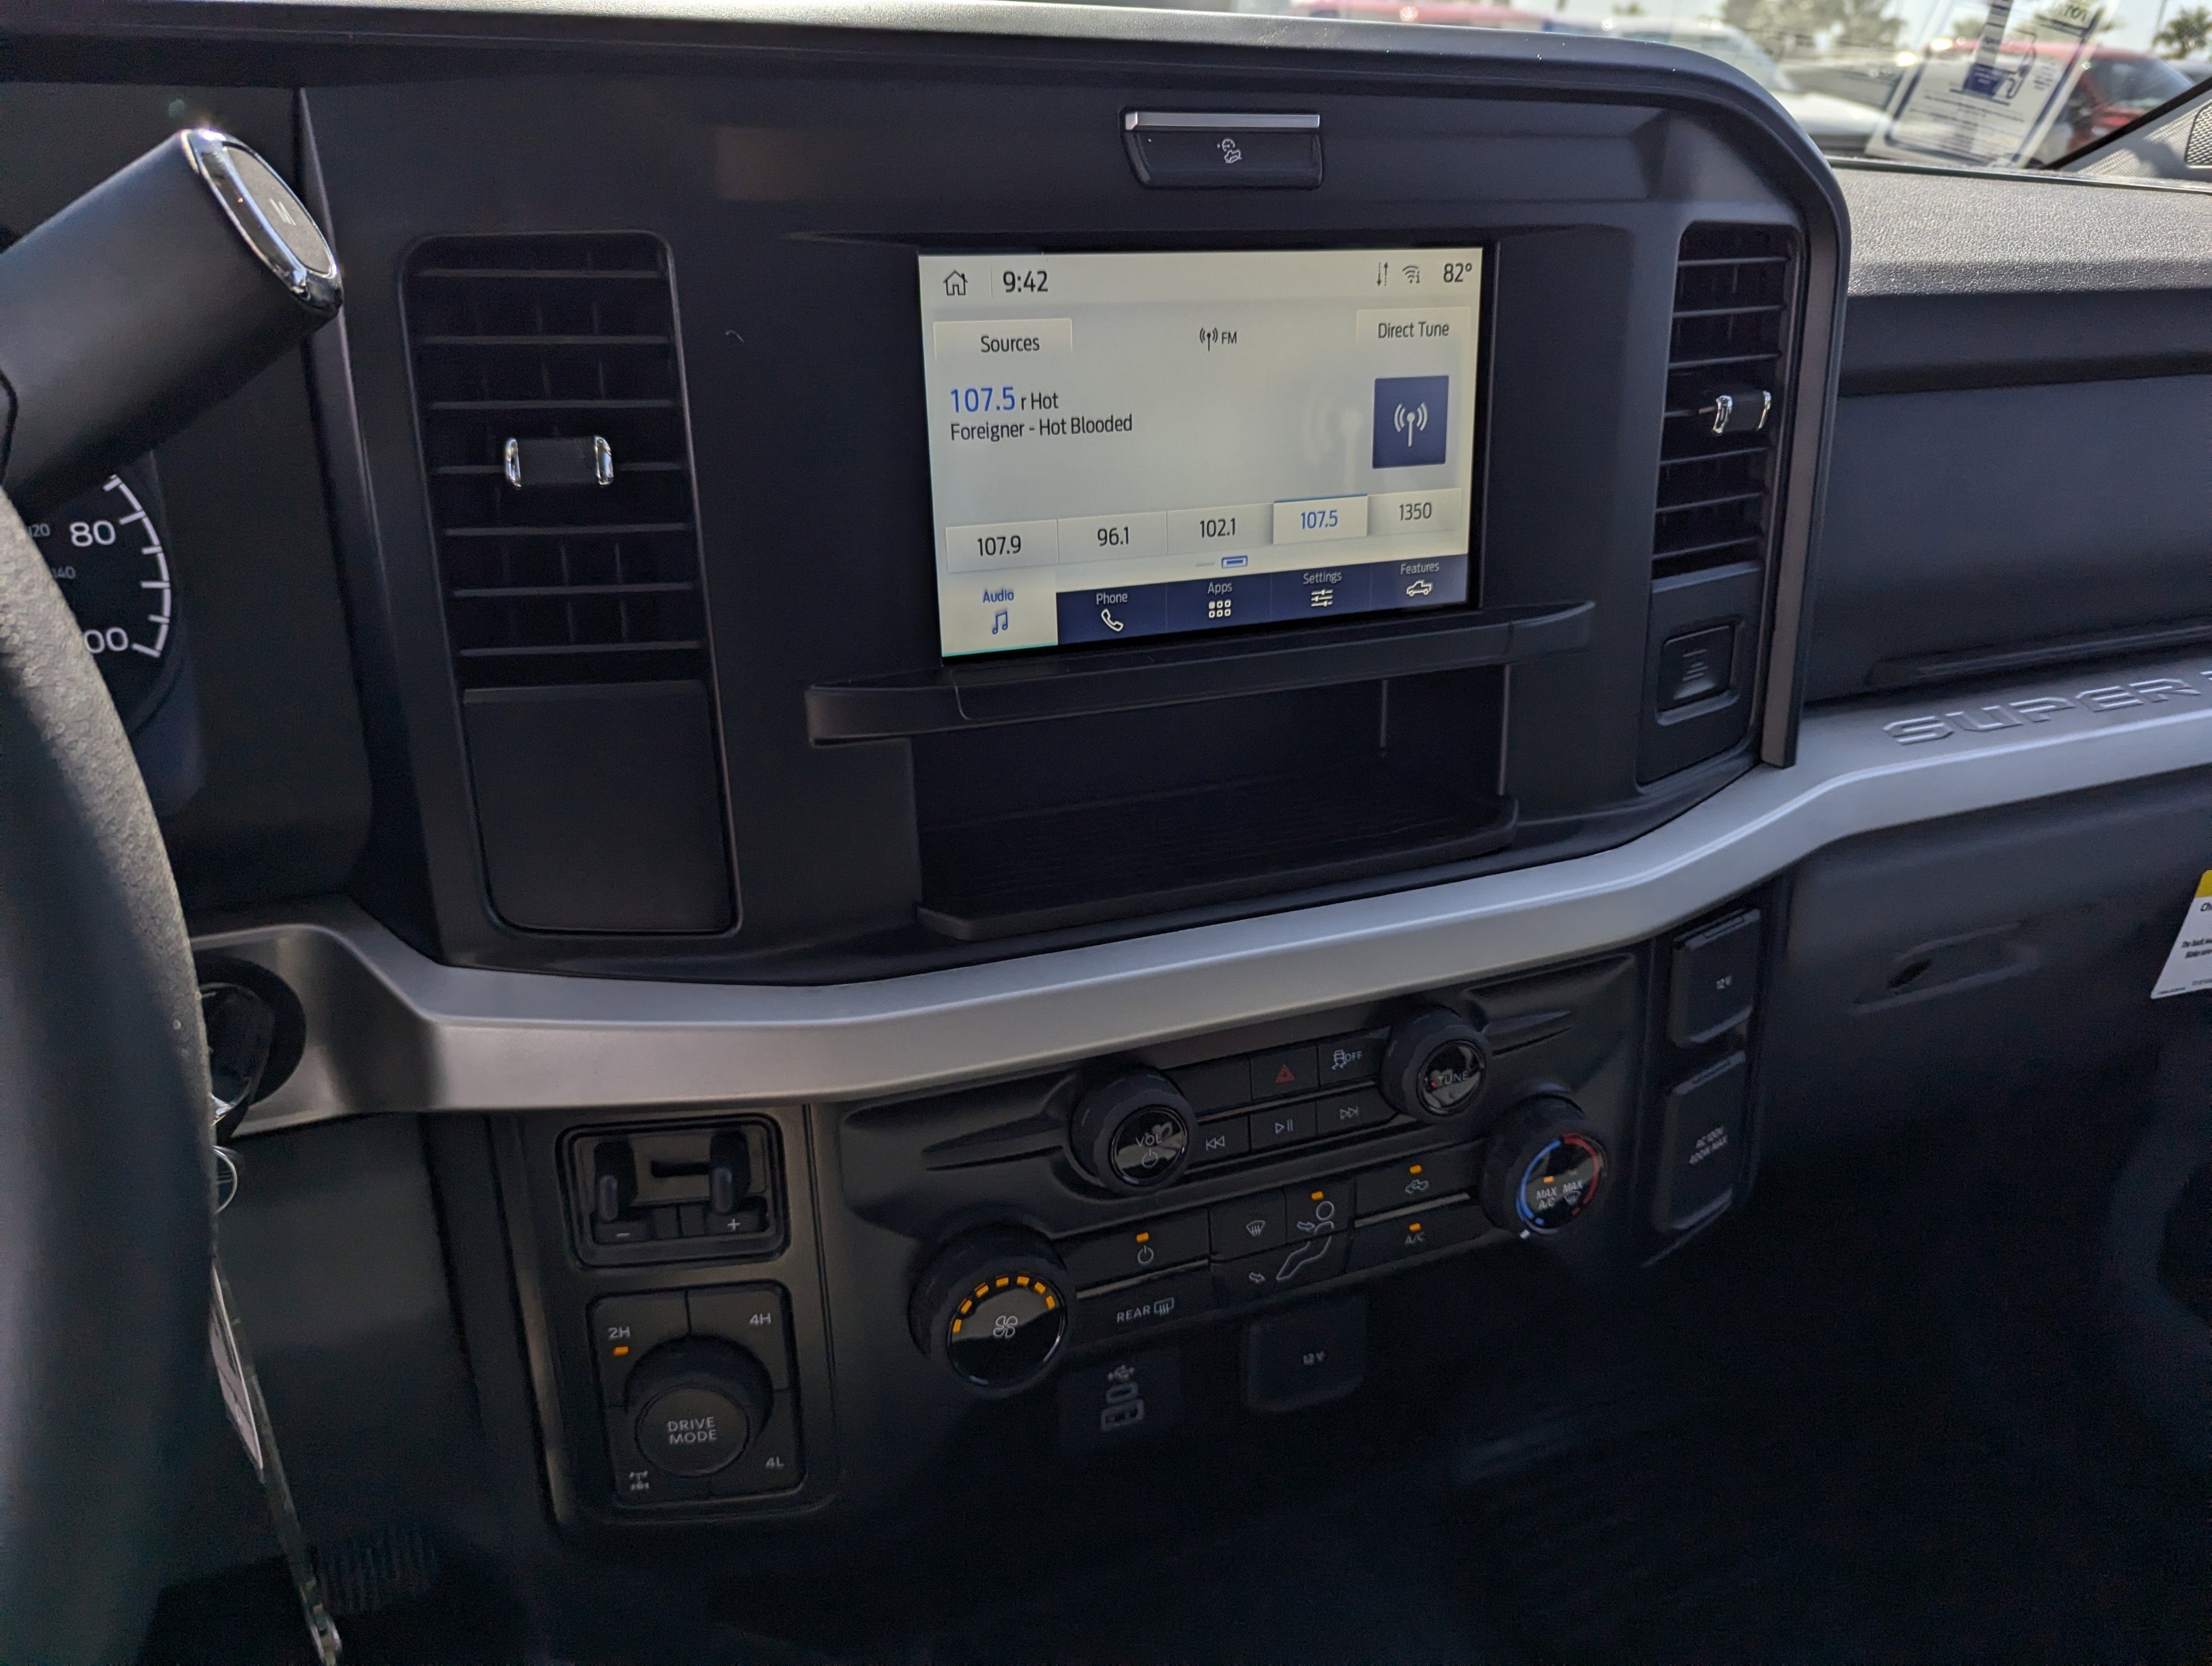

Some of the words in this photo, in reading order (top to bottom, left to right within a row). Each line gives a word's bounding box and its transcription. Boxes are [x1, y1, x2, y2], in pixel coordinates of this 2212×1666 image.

[1003, 270, 1049, 293] 9:42
[1221, 330, 1237, 345] FM
[1378, 321, 1414, 339] Direct
[1418, 321, 1449, 337] Tune
[981, 335, 1040, 353] Sources
[950, 386, 1015, 413] 107.5
[1020, 396, 1027, 411] r
[1031, 393, 1058, 410] Hot
[951, 421, 1025, 442] Foreigner
[1039, 418, 1066, 435] Hot
[1071, 414, 1133, 434] Blooded
[1300, 509, 1338, 529] 107.5
[1399, 502, 1432, 521] 1350
[70, 521, 116, 547] 80
[1097, 526, 1130, 546] 96.1
[1199, 518, 1236, 539] 102.1
[977, 535, 1021, 557] 107.9
[1400, 561, 1439, 575] Features
[1303, 570, 1342, 586] Settings
[982, 588, 1014, 604] Audio
[1207, 581, 1232, 595] Apps
[1096, 591, 1128, 605] Phone
[83, 627, 128, 653] 00
[1883, 678, 2201, 745] SUPER
[1345, 1050, 1362, 1062] OFF
[1437, 1071, 1469, 1085] TUNE
[1136, 1133, 1162, 1147] VOL
[1536, 1187, 1557, 1200] MAX
[750, 1313, 771, 1325] 4H
[1116, 1305, 1151, 1323] REAR
[609, 1328, 630, 1339] 2H
[668, 1418, 716, 1432] DRIVE
[669, 1429, 717, 1444] MODE
[766, 1457, 784, 1468] 4L
